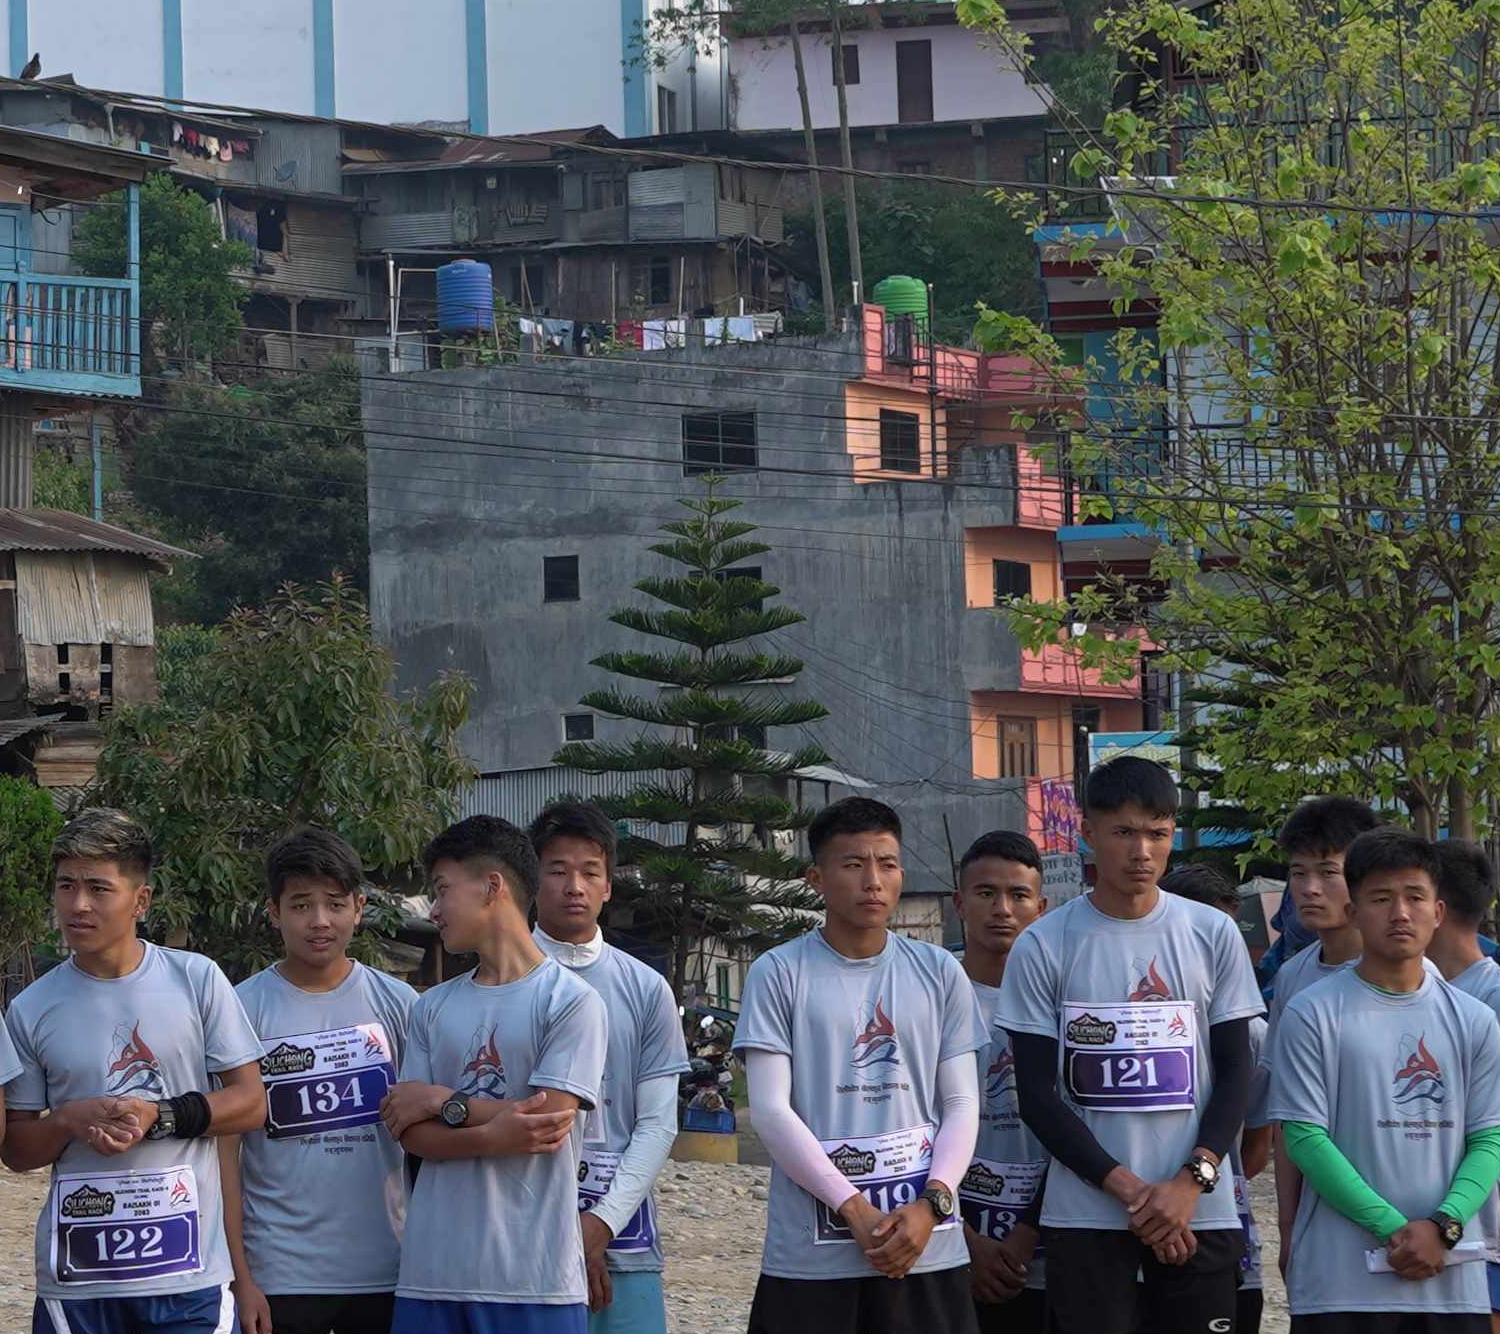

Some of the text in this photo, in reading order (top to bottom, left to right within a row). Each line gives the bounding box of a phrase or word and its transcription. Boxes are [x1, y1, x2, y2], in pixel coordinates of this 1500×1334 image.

[1100, 1056, 1158, 1088] 121
[298, 1077, 364, 1115] 134
[978, 1209, 1017, 1241] 13
[95, 1226, 163, 1261] 122
